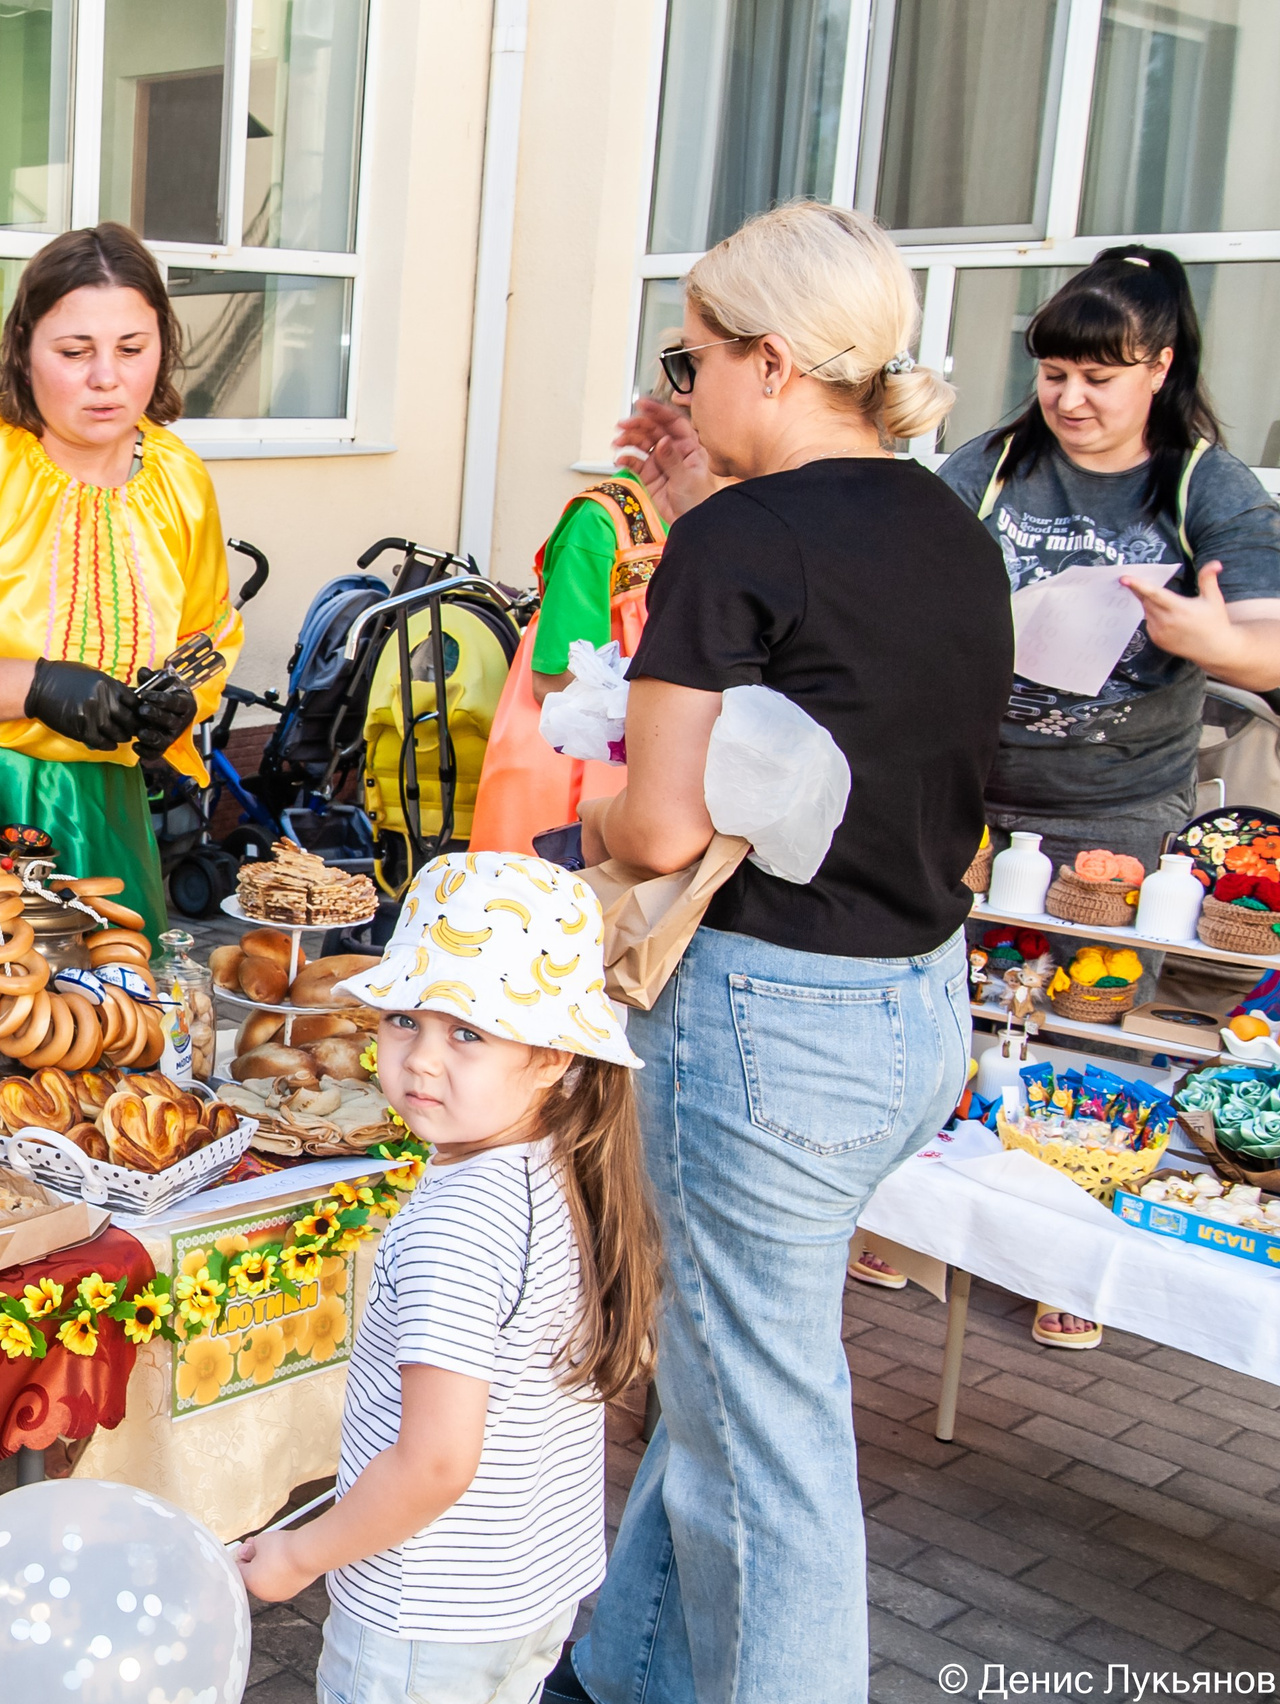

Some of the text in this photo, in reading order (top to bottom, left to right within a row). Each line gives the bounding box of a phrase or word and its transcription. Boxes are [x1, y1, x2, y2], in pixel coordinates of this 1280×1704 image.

[1022, 512, 1053, 525] your
[996, 507, 1126, 565] your mindset
[1198, 1224, 1256, 1254] ПАЗЛ
